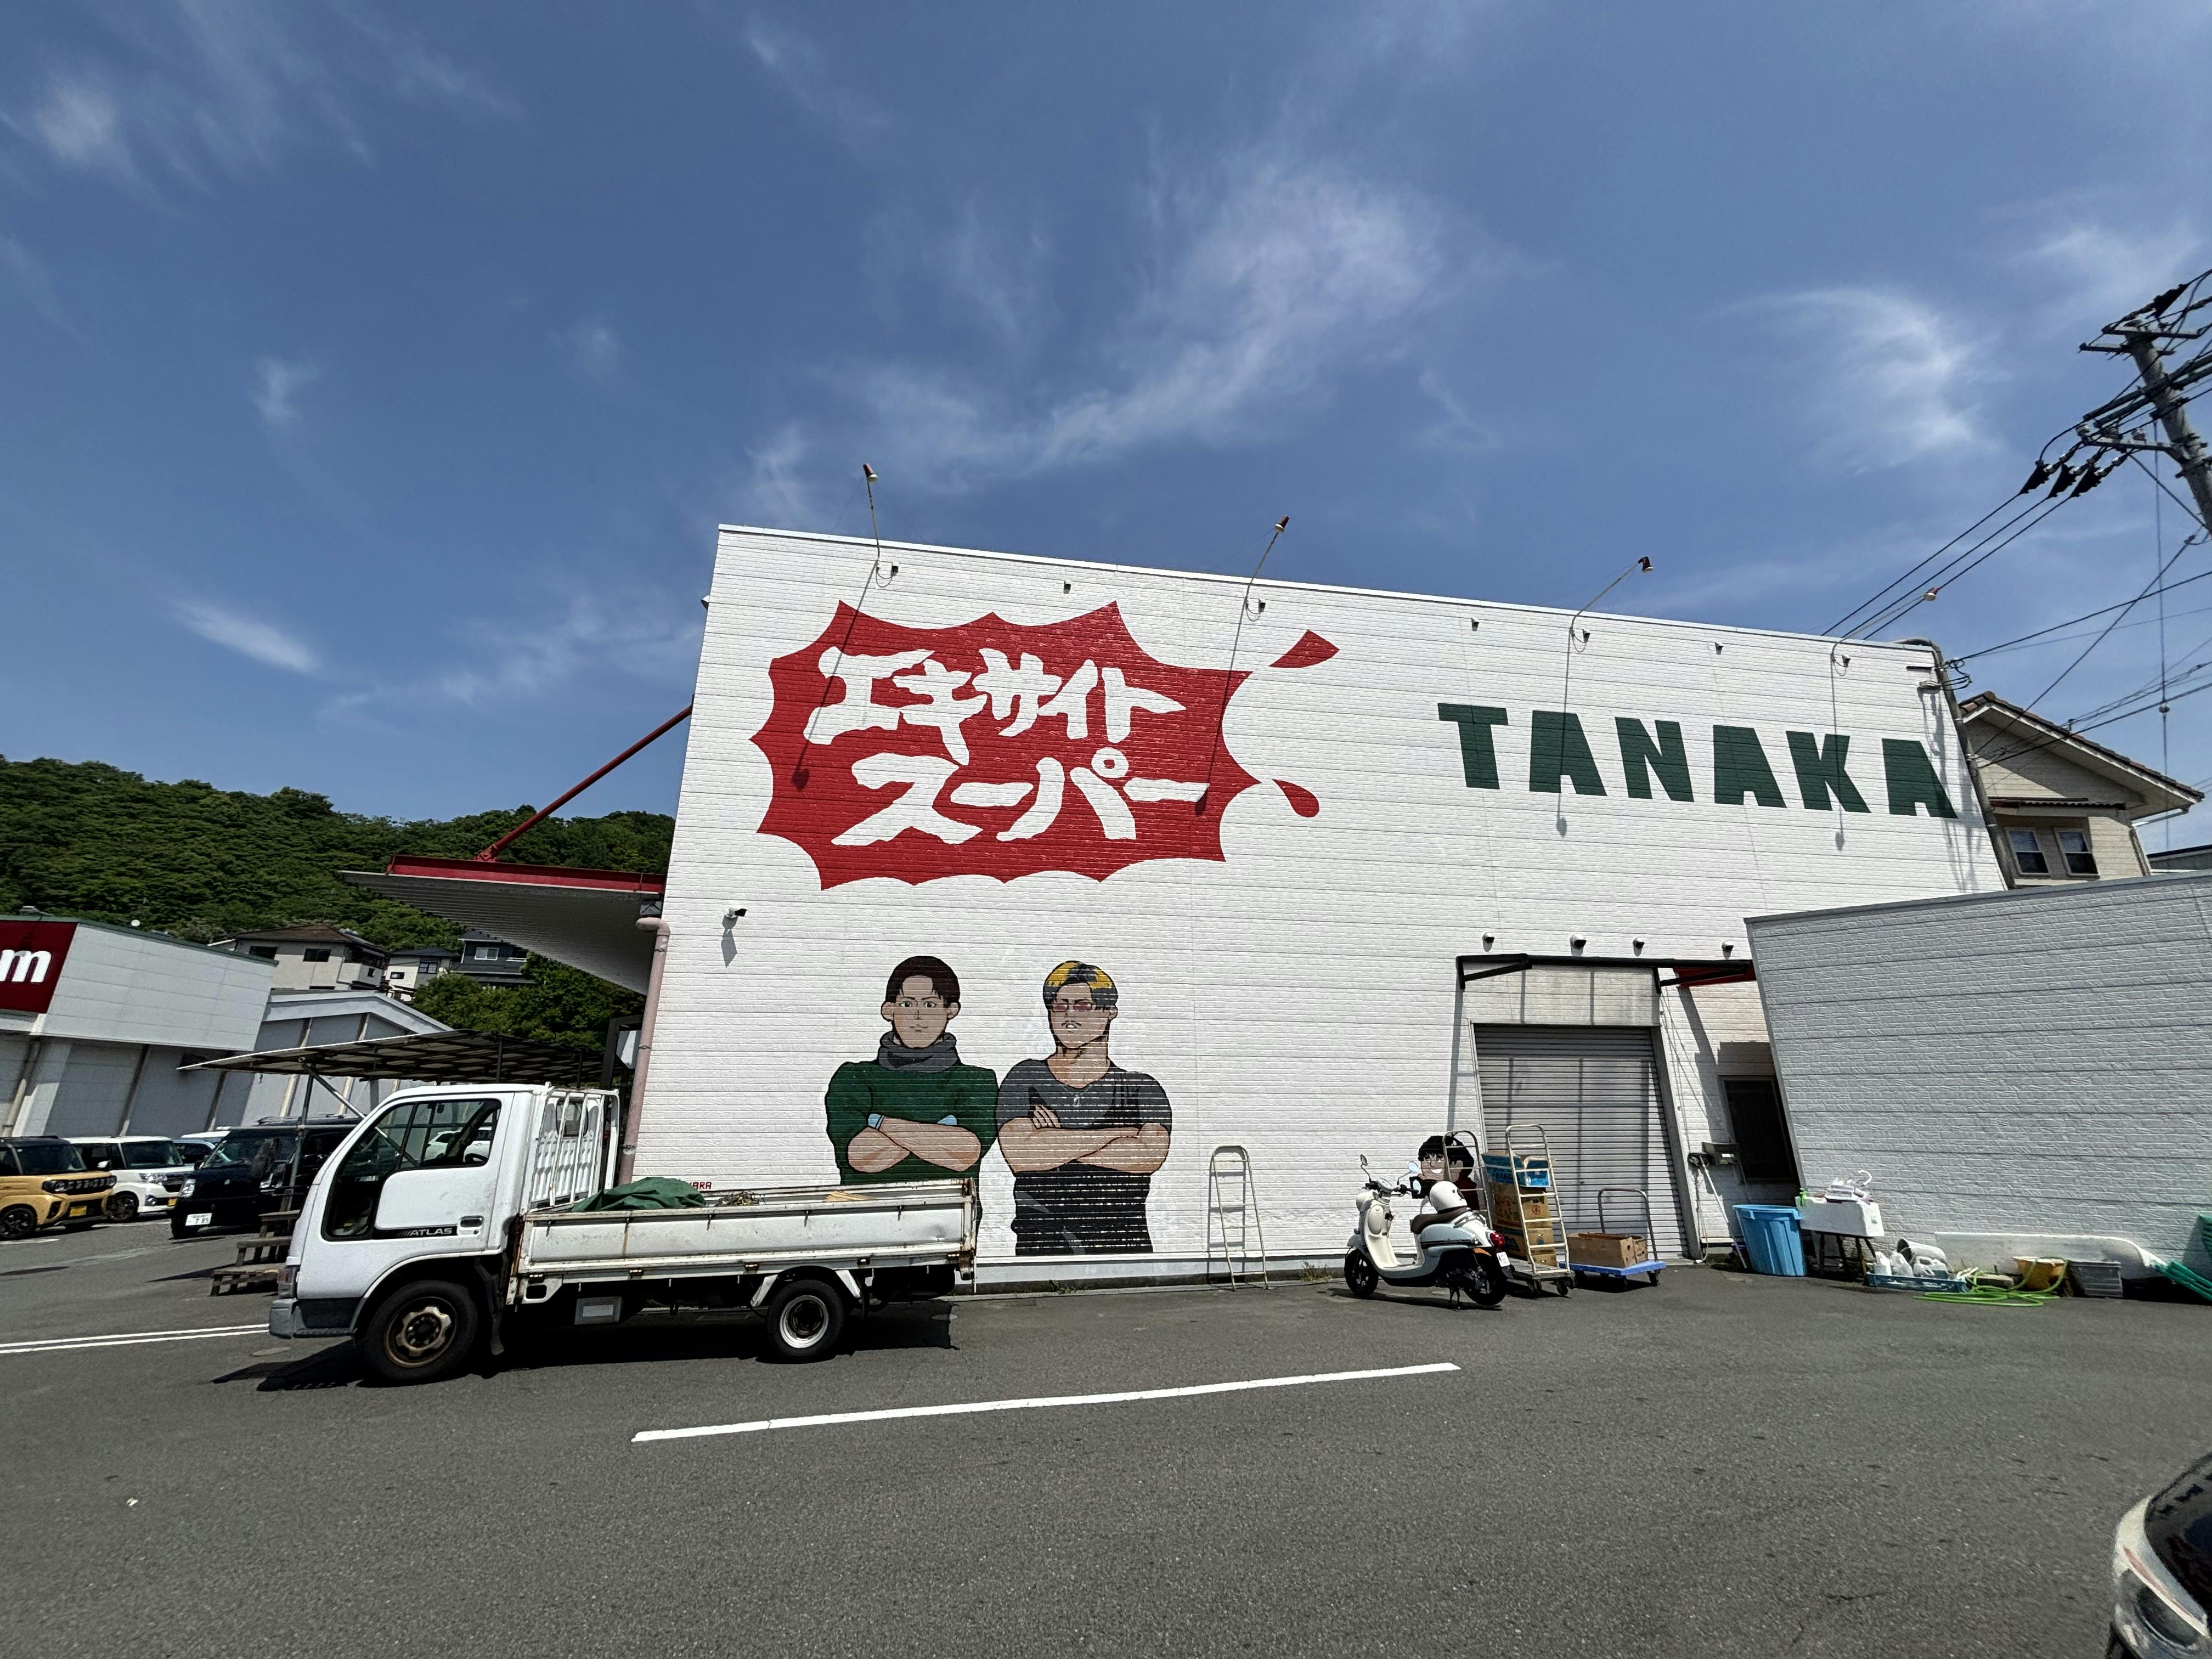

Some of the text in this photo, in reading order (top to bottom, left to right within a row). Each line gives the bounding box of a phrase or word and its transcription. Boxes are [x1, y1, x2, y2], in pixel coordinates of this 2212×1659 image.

[803, 646, 1186, 766] エキサイト
[831, 748, 1210, 845] スーパー
[1437, 703, 1958, 818] TANAKA
[409, 1228, 453, 1236] ATLAS
